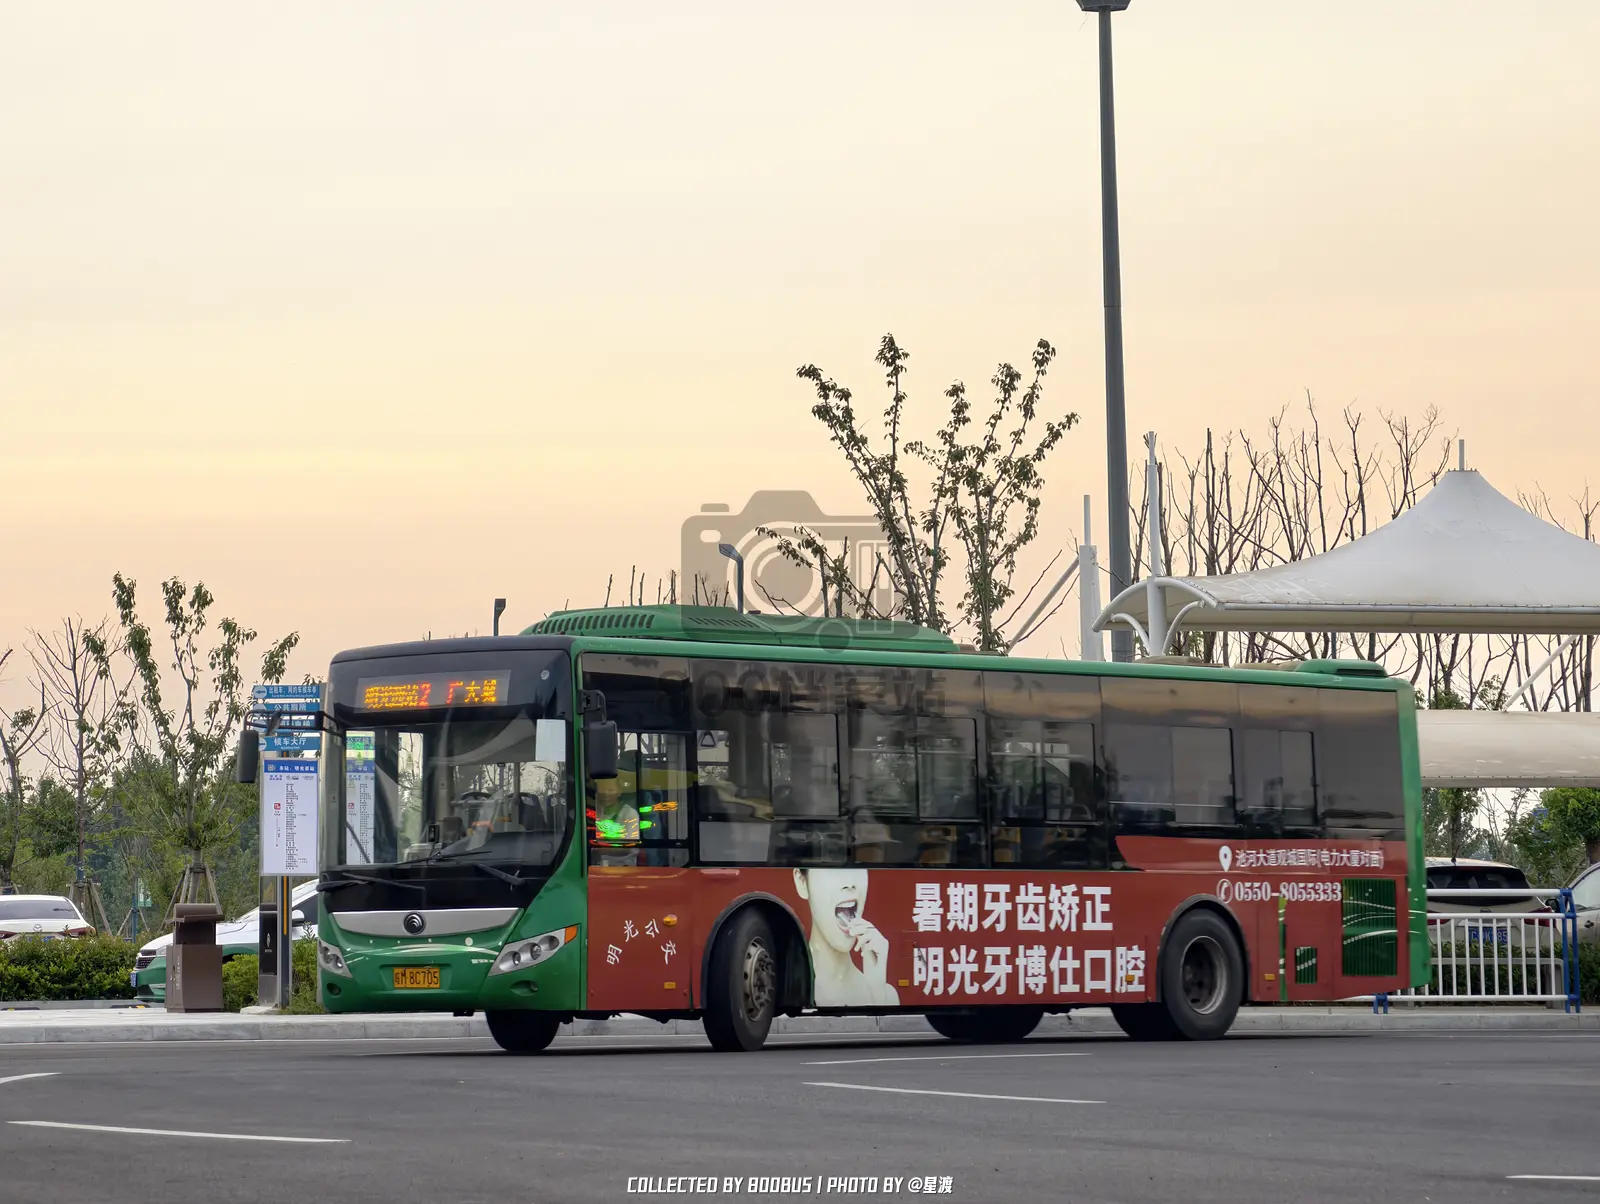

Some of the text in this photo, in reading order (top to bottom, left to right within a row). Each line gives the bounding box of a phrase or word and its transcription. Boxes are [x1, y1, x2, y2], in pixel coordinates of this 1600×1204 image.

[274, 737, 307, 746] 候车大厅
[911, 882, 1114, 933] 暑期牙齿矫正
[1234, 881, 1342, 902] 0550-8055333
[912, 944, 1147, 996] 明光牙博仕口腔
